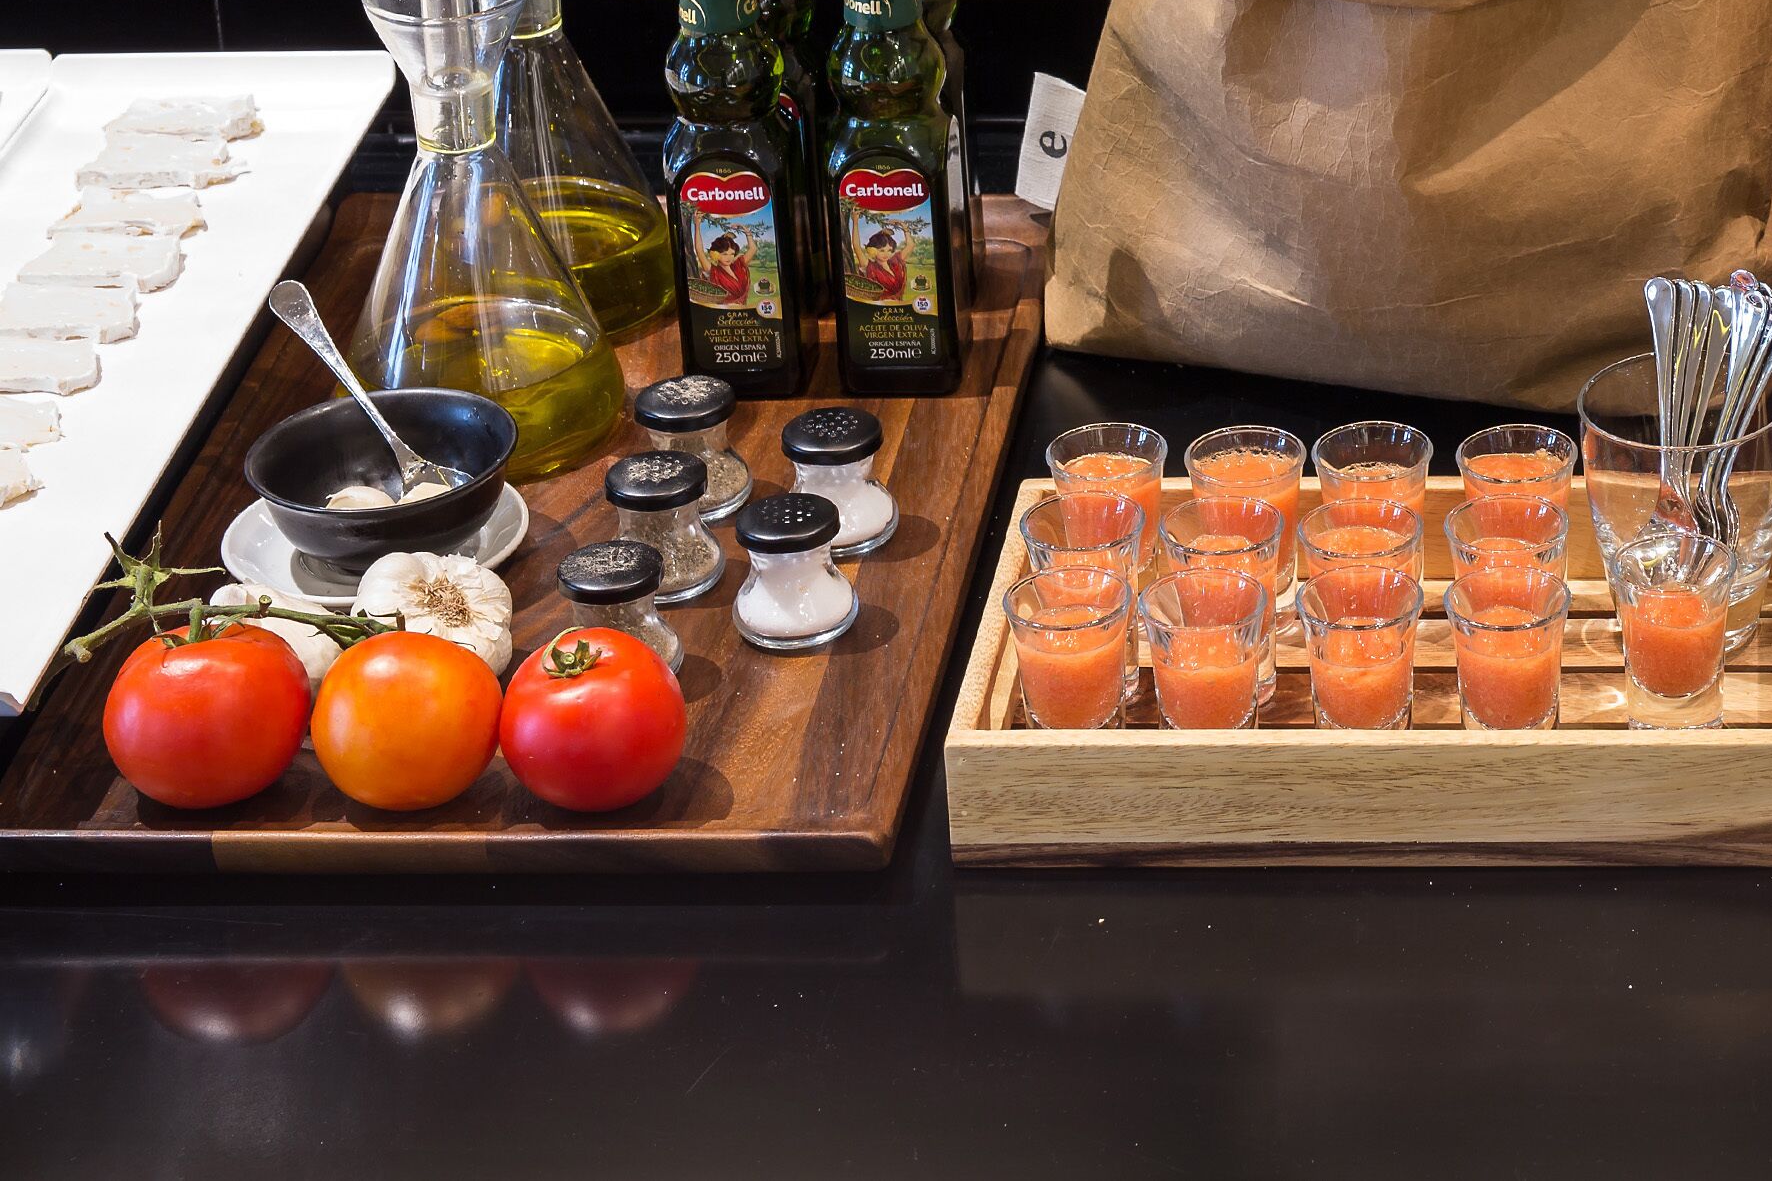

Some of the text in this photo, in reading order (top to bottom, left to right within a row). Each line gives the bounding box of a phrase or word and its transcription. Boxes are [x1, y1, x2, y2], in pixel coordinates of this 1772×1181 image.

[687, 186, 765, 202] Carbonell
[845, 183, 924, 197] Carbonell
[734, 328, 745, 336] DE
[859, 324, 888, 332] ACEITE
[709, 335, 740, 343] VIRGEN
[864, 331, 895, 339] VIRGEN
[741, 343, 767, 351] ESPAÑA
[895, 339, 921, 347] ESPAÑA
